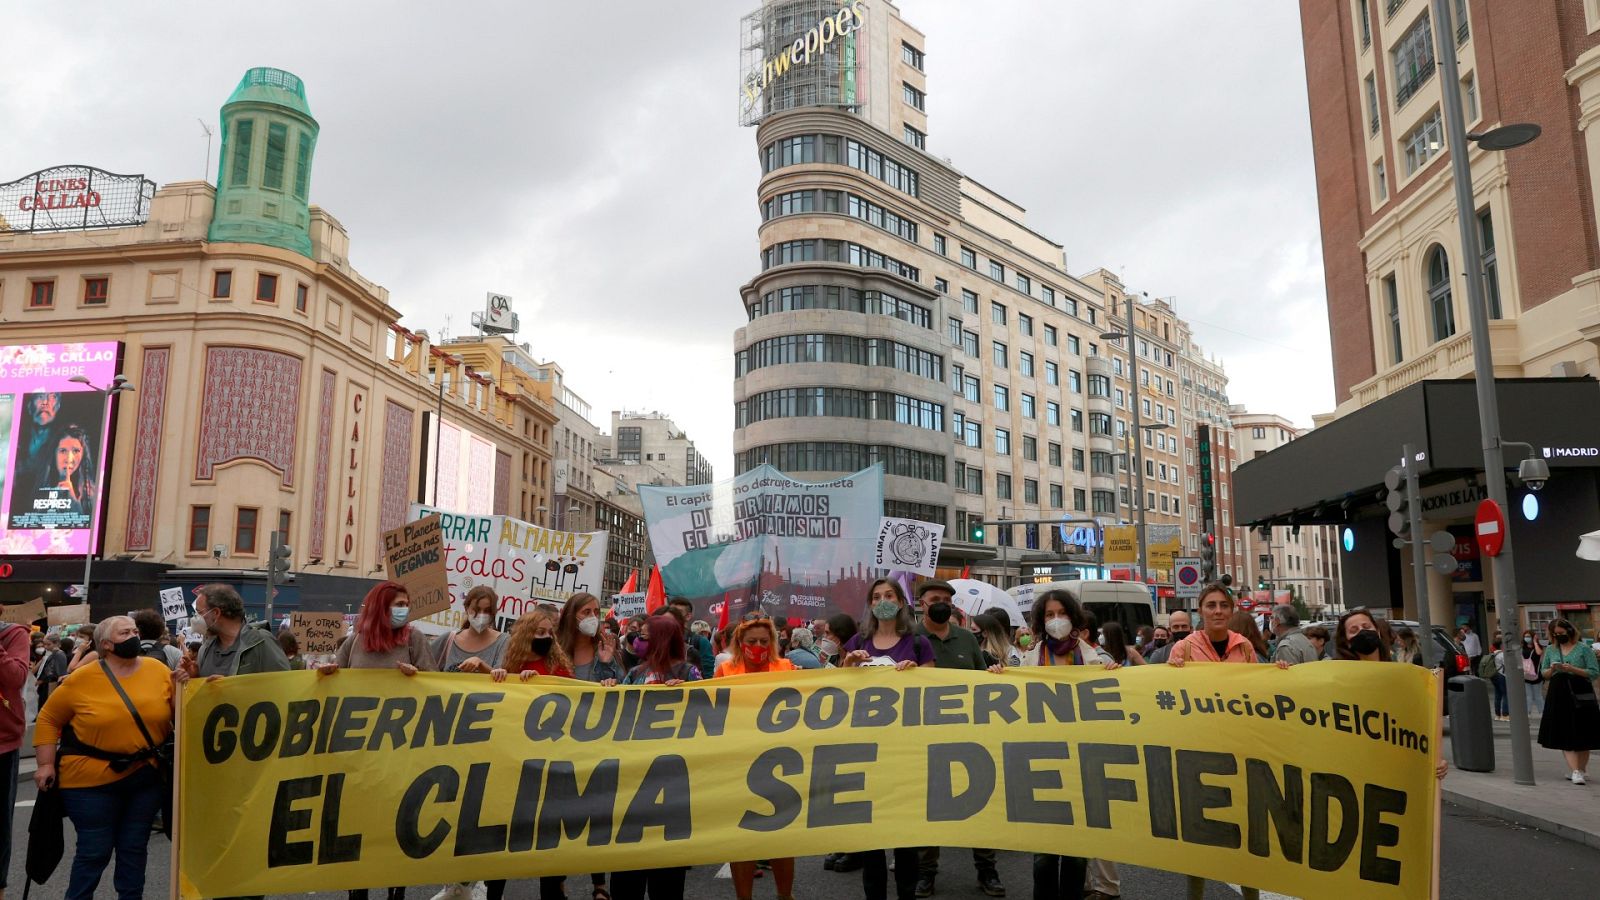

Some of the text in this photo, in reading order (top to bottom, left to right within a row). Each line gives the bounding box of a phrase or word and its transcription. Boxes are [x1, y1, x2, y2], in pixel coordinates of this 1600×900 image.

[36, 177, 87, 193] CINES
[19, 191, 102, 212] CALLAO
[11, 365, 85, 378] SEPTIEMBRE
[60, 350, 114, 363] CALLAO
[1556, 447, 1599, 457] MADRID
[344, 393, 362, 555] CALLAO
[1200, 441, 1211, 508] HOTEL
[49, 491, 59, 499] NO
[667, 495, 678, 507] El
[681, 484, 750, 507] capitmo
[752, 476, 791, 491] destruye
[1449, 490, 1461, 506] DE
[1463, 486, 1476, 502] LA
[385, 521, 441, 552] EL Planeta
[389, 534, 440, 564] necesita más
[500, 518, 593, 558] ALMARAZ
[683, 530, 709, 552] EL
[876, 520, 893, 565] CLIMATIC
[929, 532, 938, 569] ALARM!
[394, 547, 440, 578] VEGANOS
[443, 543, 525, 583] todas
[293, 613, 341, 629] HAY OTRAS
[305, 627, 334, 639] FORMAS
[202, 678, 1141, 765] GOBIERNE QUIEN GOBIERNE,
[1155, 689, 1429, 754] #JuicioPorElClima
[267, 741, 1408, 886] EL CLIMA SE DEFIENDE
